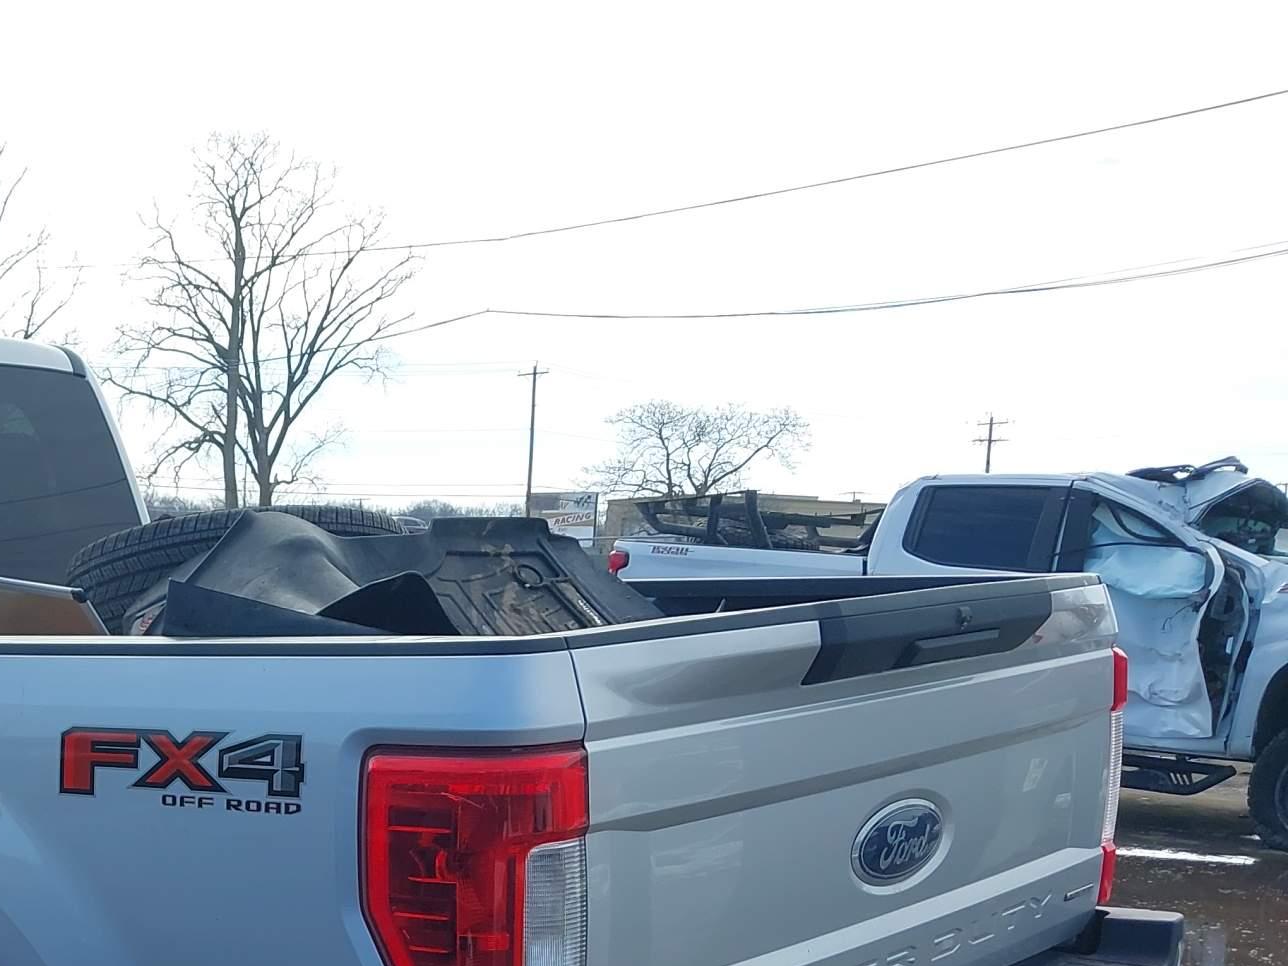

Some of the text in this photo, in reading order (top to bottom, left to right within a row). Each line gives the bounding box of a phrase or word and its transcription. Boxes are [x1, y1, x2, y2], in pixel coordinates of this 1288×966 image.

[554, 512, 592, 526] RACING
[59, 727, 305, 797] FX4
[162, 794, 302, 815] OFF ROAD
[879, 816, 930, 870] Ford
[929, 893, 1053, 963] DUTY
